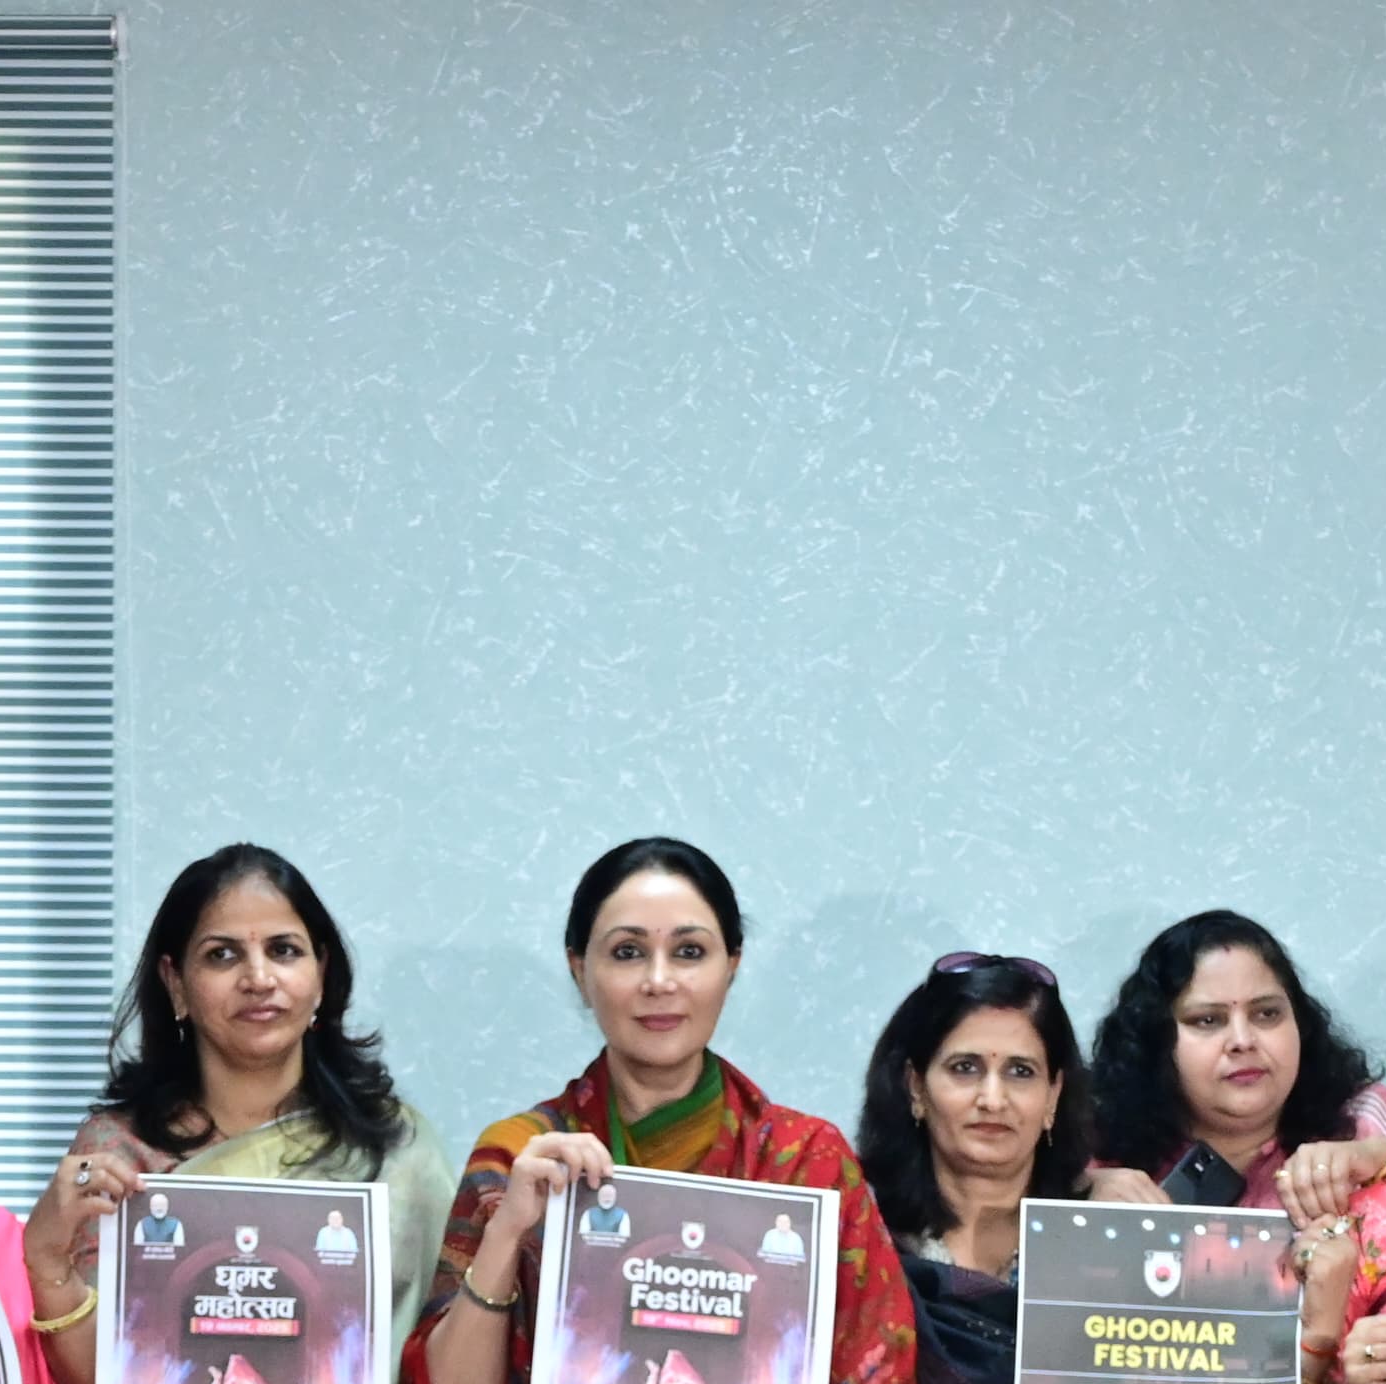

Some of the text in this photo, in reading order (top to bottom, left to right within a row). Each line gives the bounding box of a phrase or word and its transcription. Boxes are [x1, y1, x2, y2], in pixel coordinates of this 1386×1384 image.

[215, 1266, 278, 1295] घूमर
[623, 1257, 757, 1292] Ghoomar
[194, 1290, 297, 1319] महोत्सव
[630, 1283, 743, 1317] Festival
[1084, 1315, 1236, 1345] GHOOMAR
[1094, 1343, 1225, 1371] FESTIVAL
